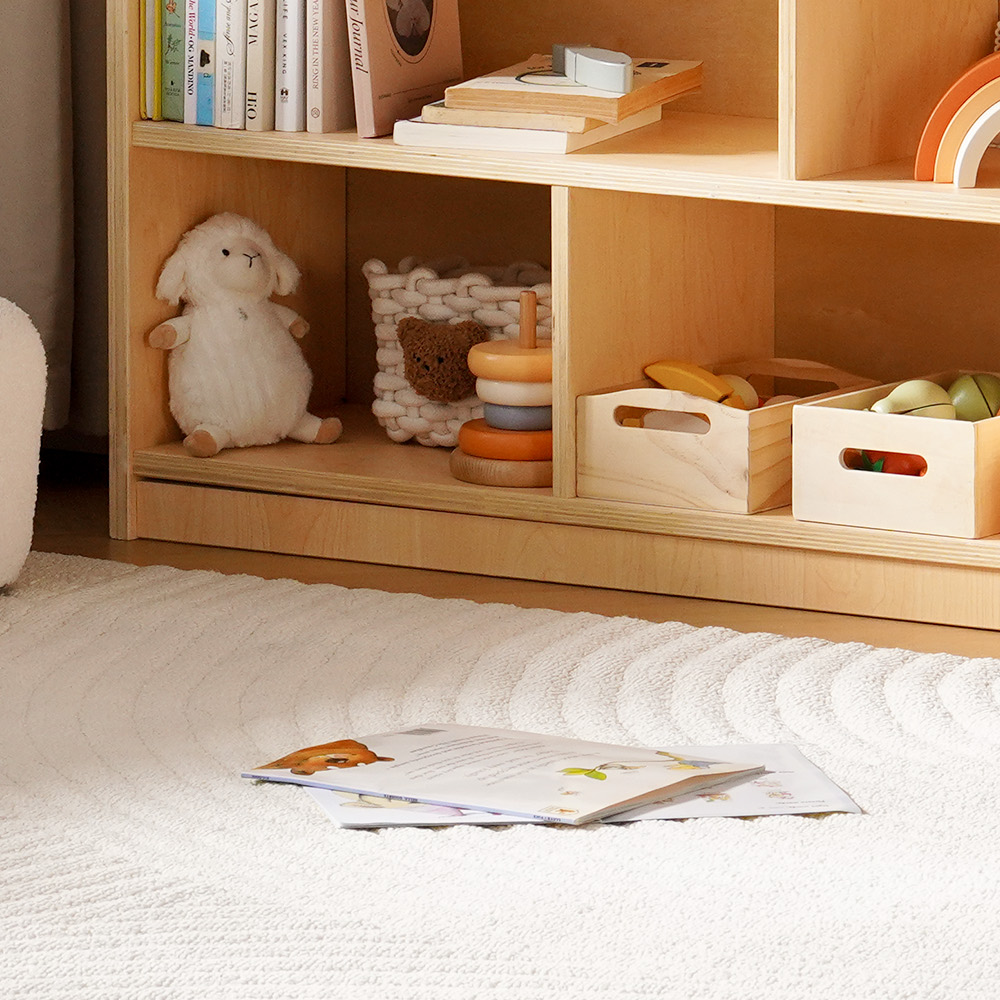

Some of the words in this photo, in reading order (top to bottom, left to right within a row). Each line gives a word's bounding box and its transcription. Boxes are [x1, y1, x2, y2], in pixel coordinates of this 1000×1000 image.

[188, 12, 196, 37] World
[187, 40, 195, 52] OG
[349, 16, 369, 74] Journal
[312, 57, 319, 68] IN
[187, 55, 195, 96] MANDINO
